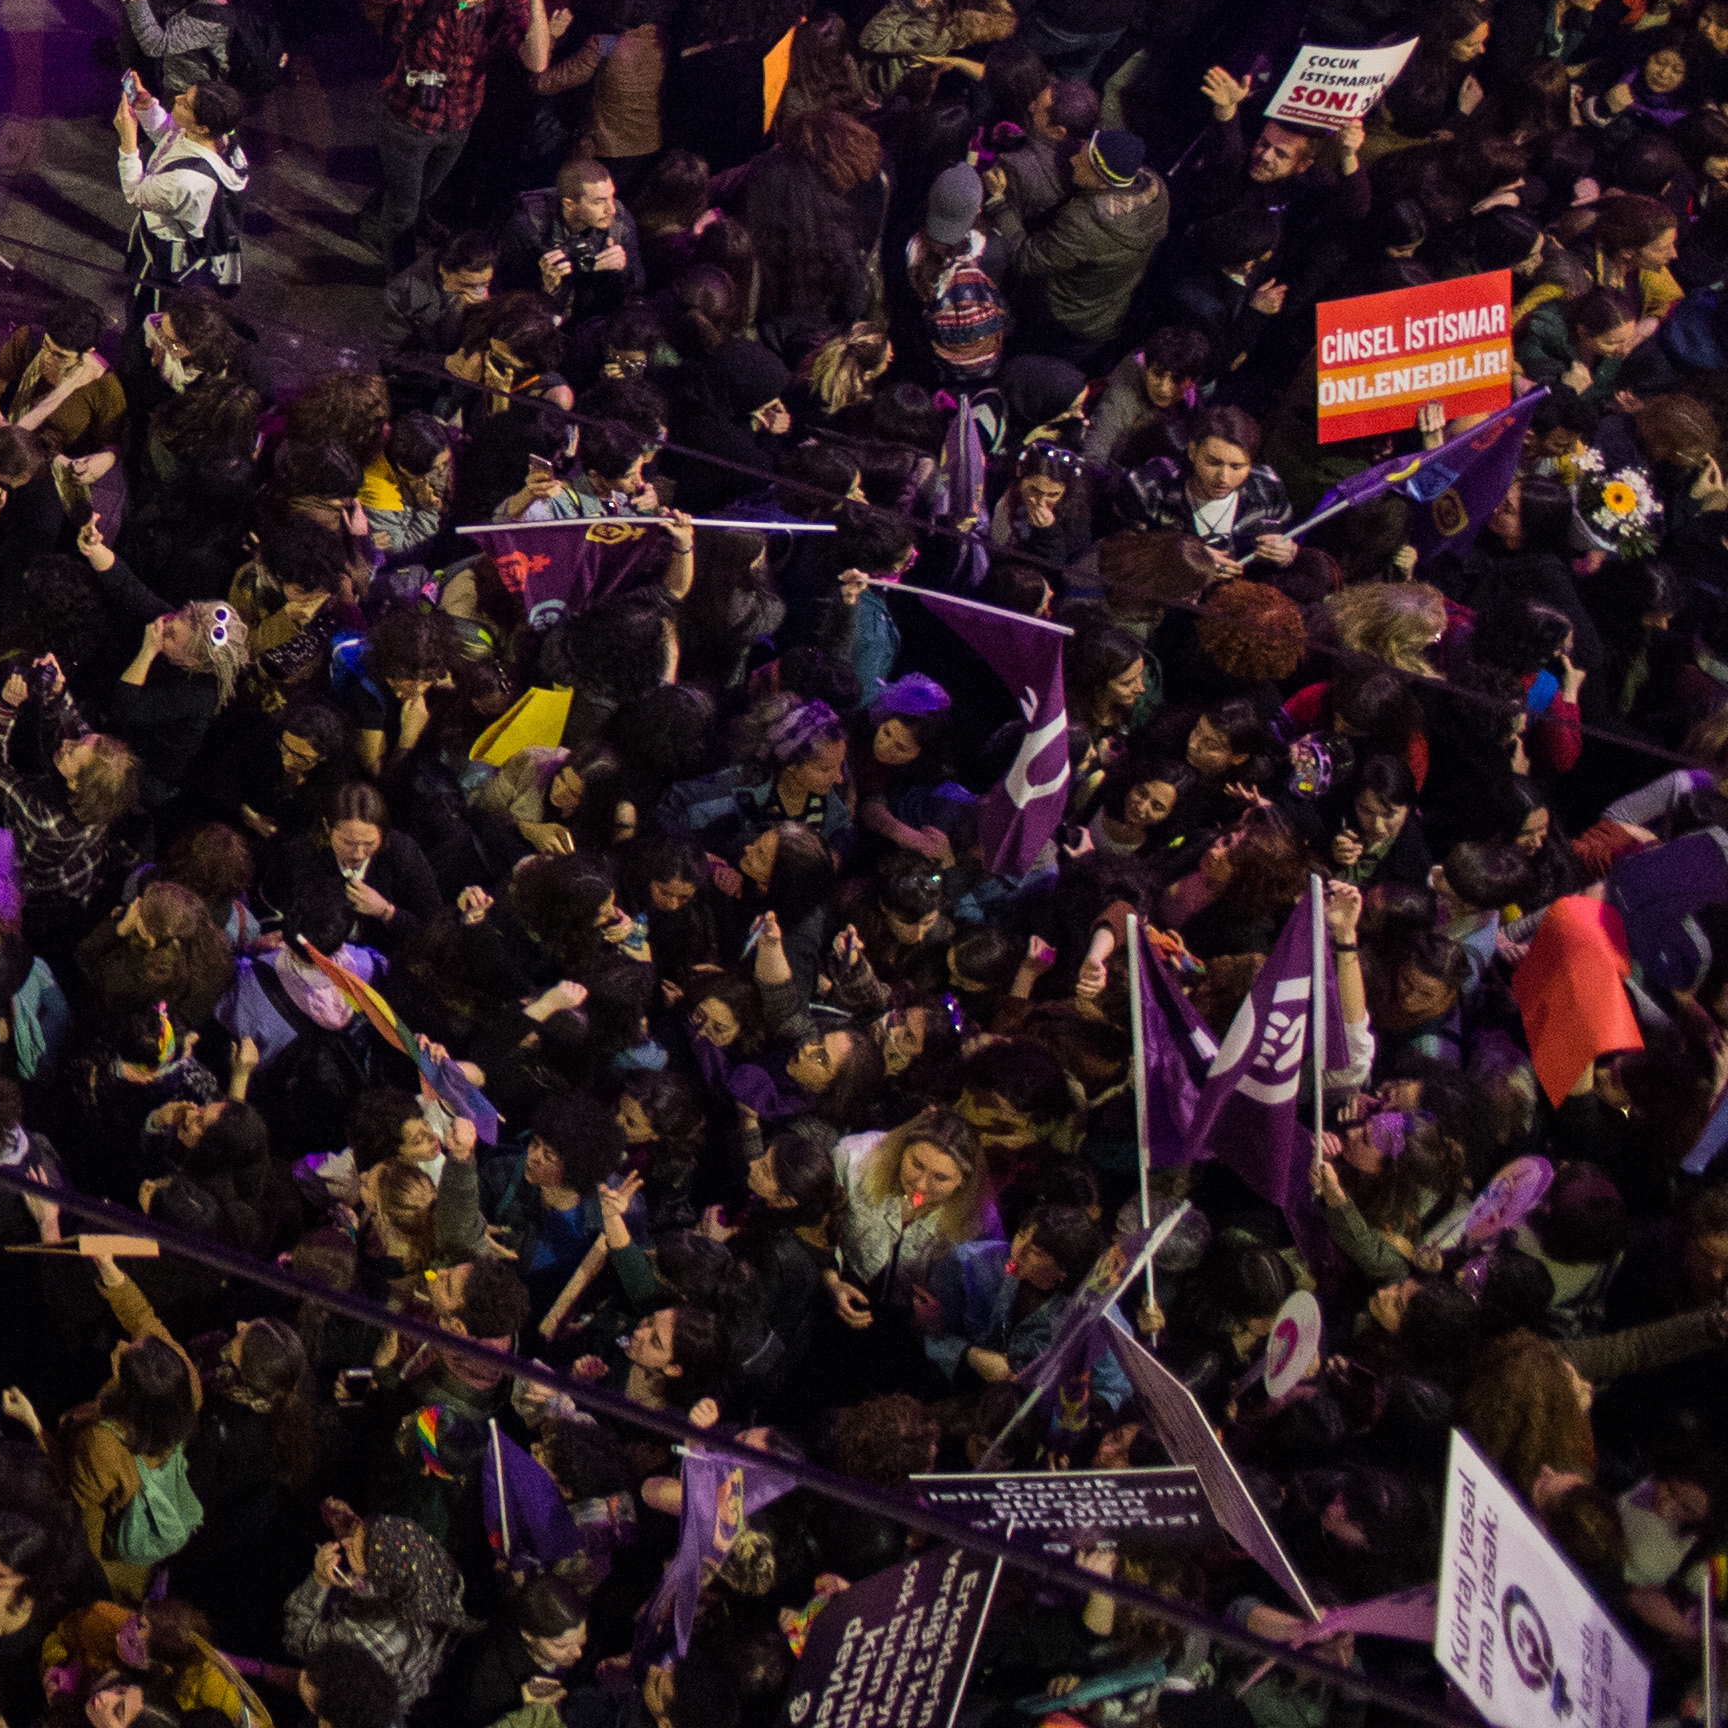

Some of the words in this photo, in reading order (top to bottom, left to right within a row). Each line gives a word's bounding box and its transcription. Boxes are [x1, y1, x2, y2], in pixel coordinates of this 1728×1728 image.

[1308, 55, 1362, 70] ÇOCUK
[1287, 85, 1359, 112] SON!
[1321, 324, 1399, 365] CİNSEL
[1404, 303, 1506, 352] İSTİSMAR
[1317, 348, 1509, 407] ÖNLENEBİLİR!
[1458, 1466, 1477, 1570] yasal
[1450, 1559, 1478, 1679] Kürtaj
[1478, 1618, 1494, 1700] ama
